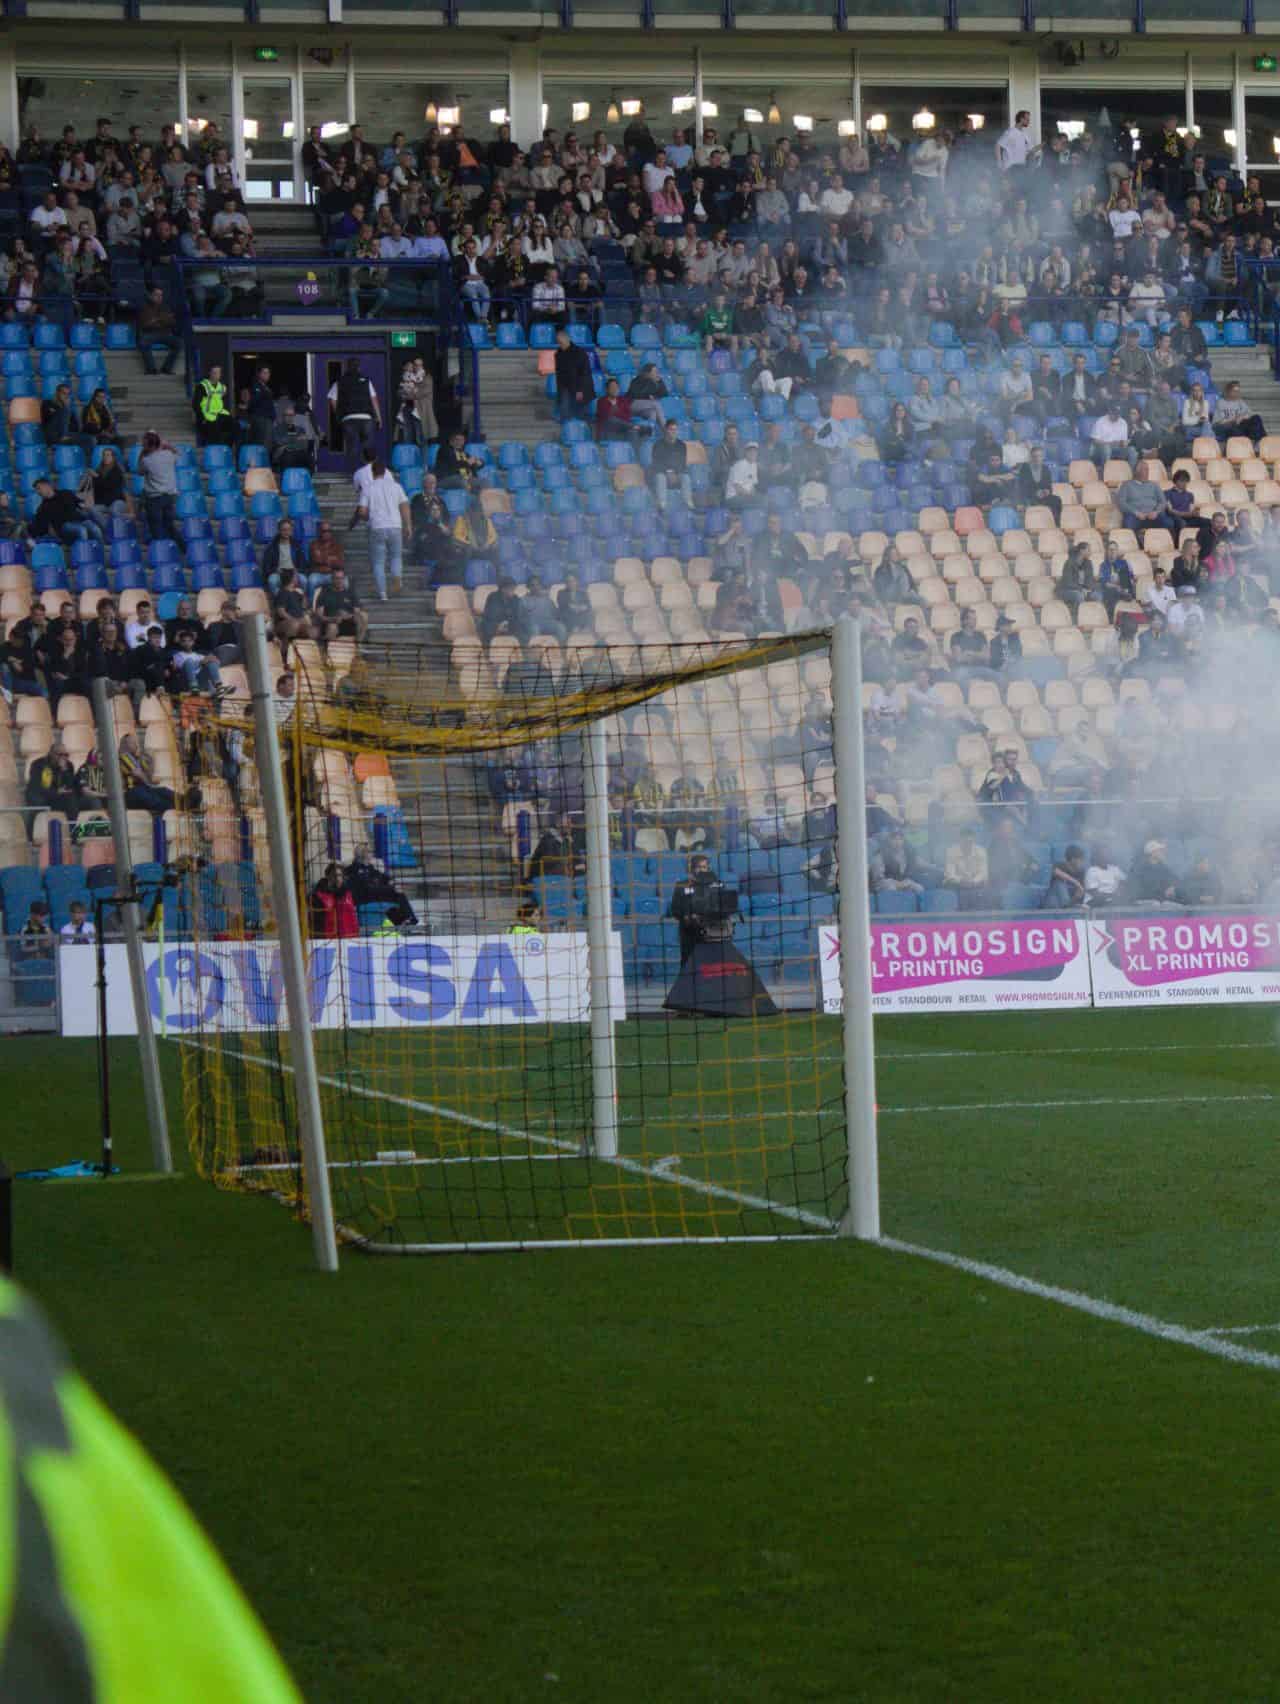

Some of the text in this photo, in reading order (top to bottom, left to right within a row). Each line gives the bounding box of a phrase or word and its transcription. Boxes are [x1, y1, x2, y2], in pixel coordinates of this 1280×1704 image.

[297, 283, 319, 295] 108
[869, 928, 1073, 957] ROMOSIGN
[872, 959, 983, 978] L PRINTING
[1127, 951, 1249, 971] XL PRINTING
